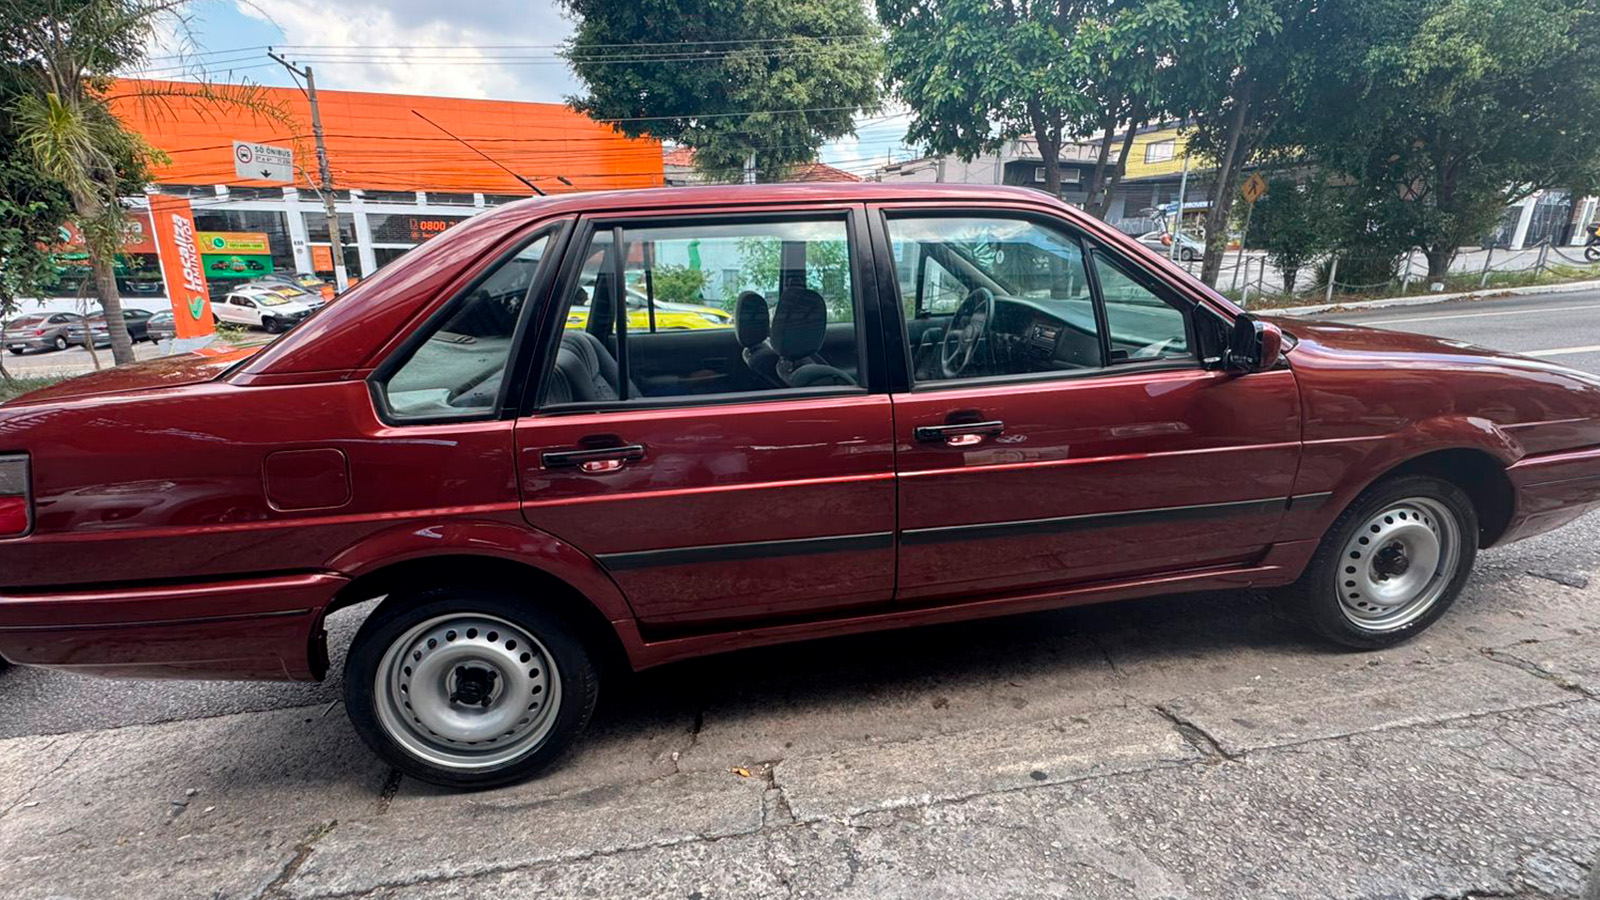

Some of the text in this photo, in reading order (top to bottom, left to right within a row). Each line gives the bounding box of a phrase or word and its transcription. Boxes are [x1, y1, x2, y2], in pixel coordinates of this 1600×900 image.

[254, 146, 291, 157] SÓ ÔNIBUS
[420, 221, 446, 231] 0800
[172, 213, 195, 292] Localiza
[181, 218, 204, 293] SEMINOVOS
